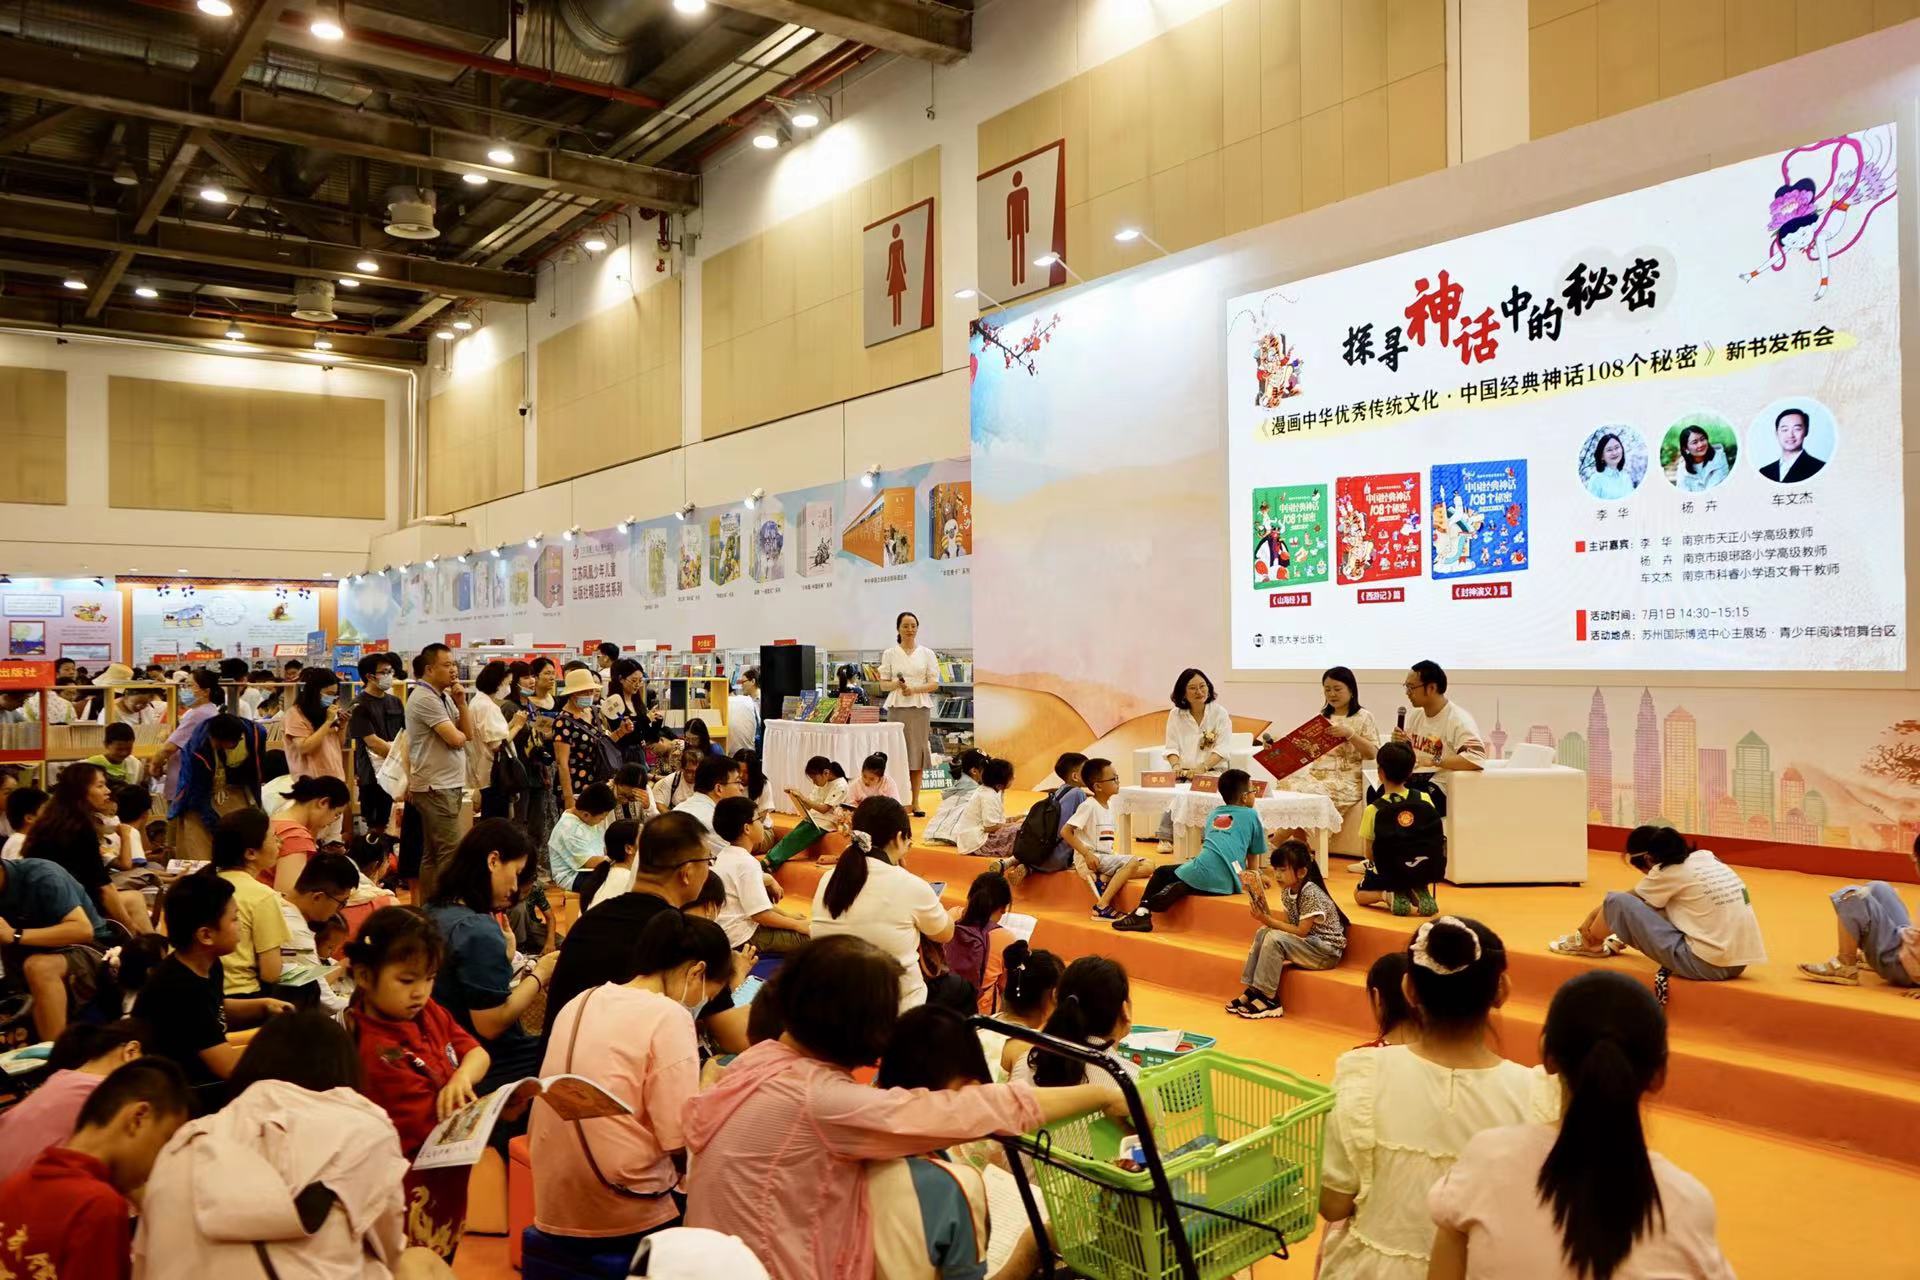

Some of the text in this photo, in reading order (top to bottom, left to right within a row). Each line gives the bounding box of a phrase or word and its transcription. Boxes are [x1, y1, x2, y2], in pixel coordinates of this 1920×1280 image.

[1342, 258, 1660, 372] 探寻神话中的秘密
[1772, 492, 1813, 507] 车文杰
[1682, 526, 1814, 547] 南京市天正小学高级教师
[1640, 562, 1841, 584] 车文杰 南京市科睿小学语文骨干教师
[1641, 608, 1676, 621] 7月1日
[1269, 634, 1325, 646] 南京大学出版社
